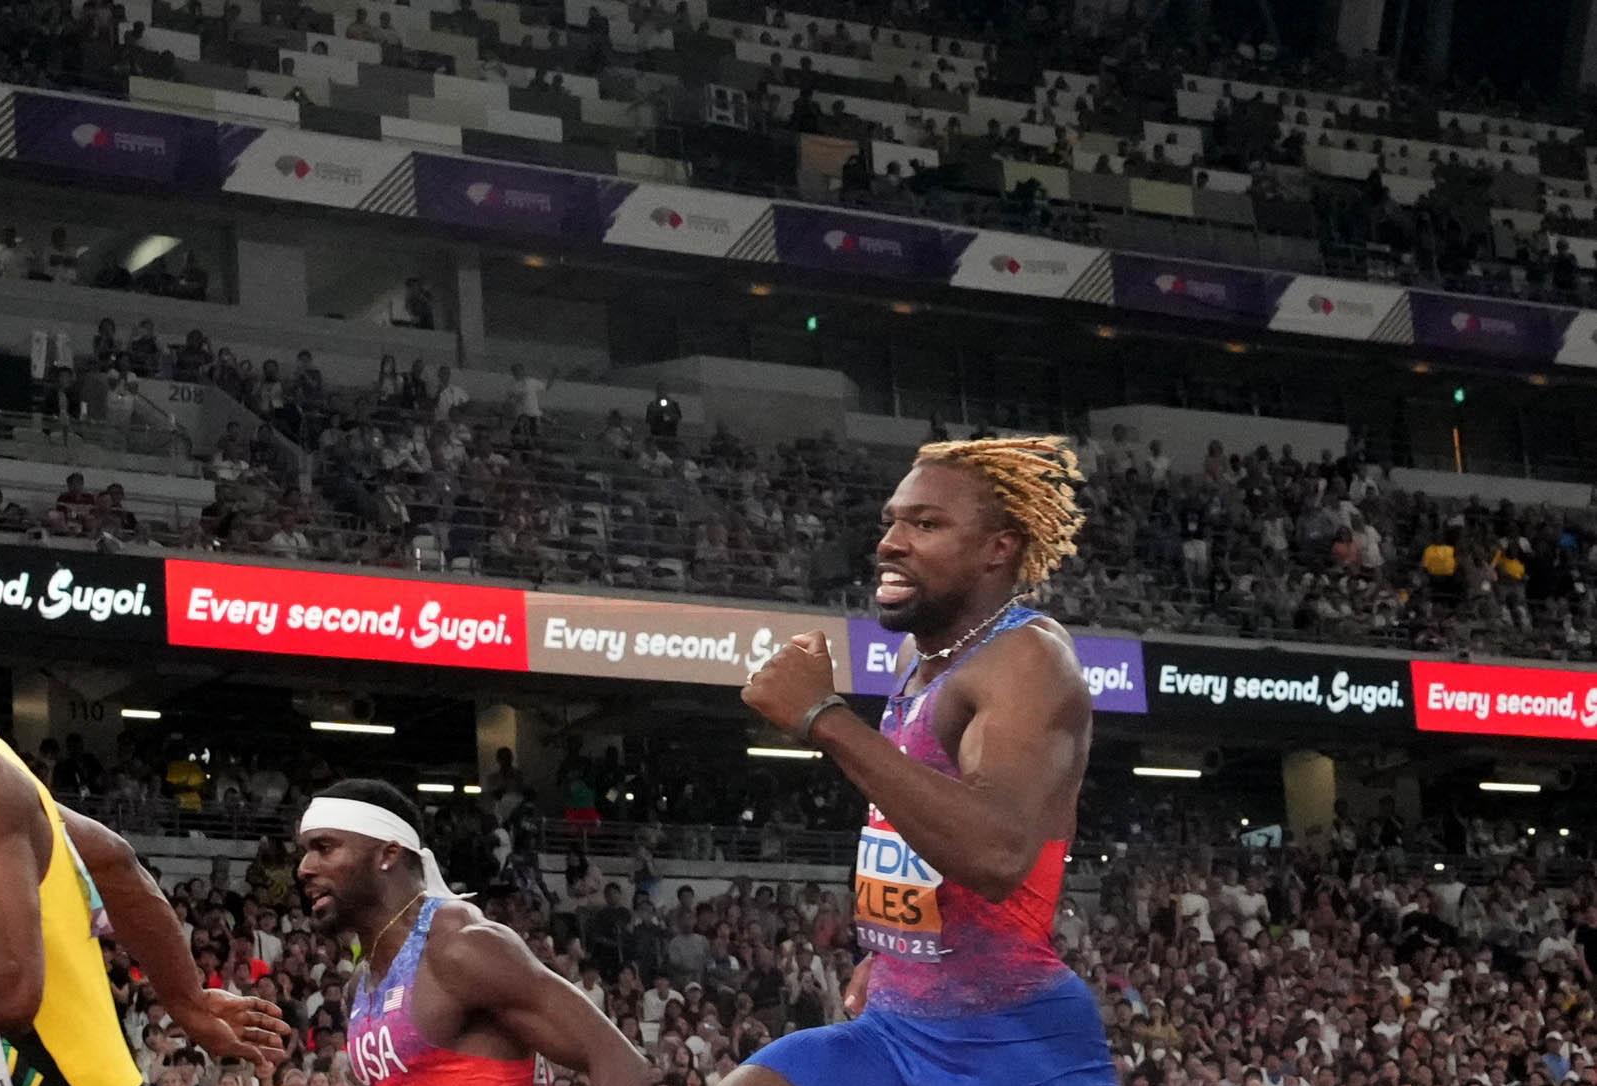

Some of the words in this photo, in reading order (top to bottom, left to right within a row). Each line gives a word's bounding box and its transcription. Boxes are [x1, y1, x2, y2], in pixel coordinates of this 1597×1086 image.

[37, 566, 152, 622] Sugoi.
[187, 587, 279, 635] Every
[286, 604, 405, 639] second,
[410, 600, 512, 651] Sugoi.
[544, 617, 627, 662] Every
[633, 631, 740, 666] second,
[1158, 664, 1228, 704] Every
[1233, 675, 1323, 706] second,
[1326, 671, 1404, 713] Sugoi.
[1427, 682, 1491, 720] Every
[1495, 691, 1577, 720] second,
[911, 939, 939, 956] 25
